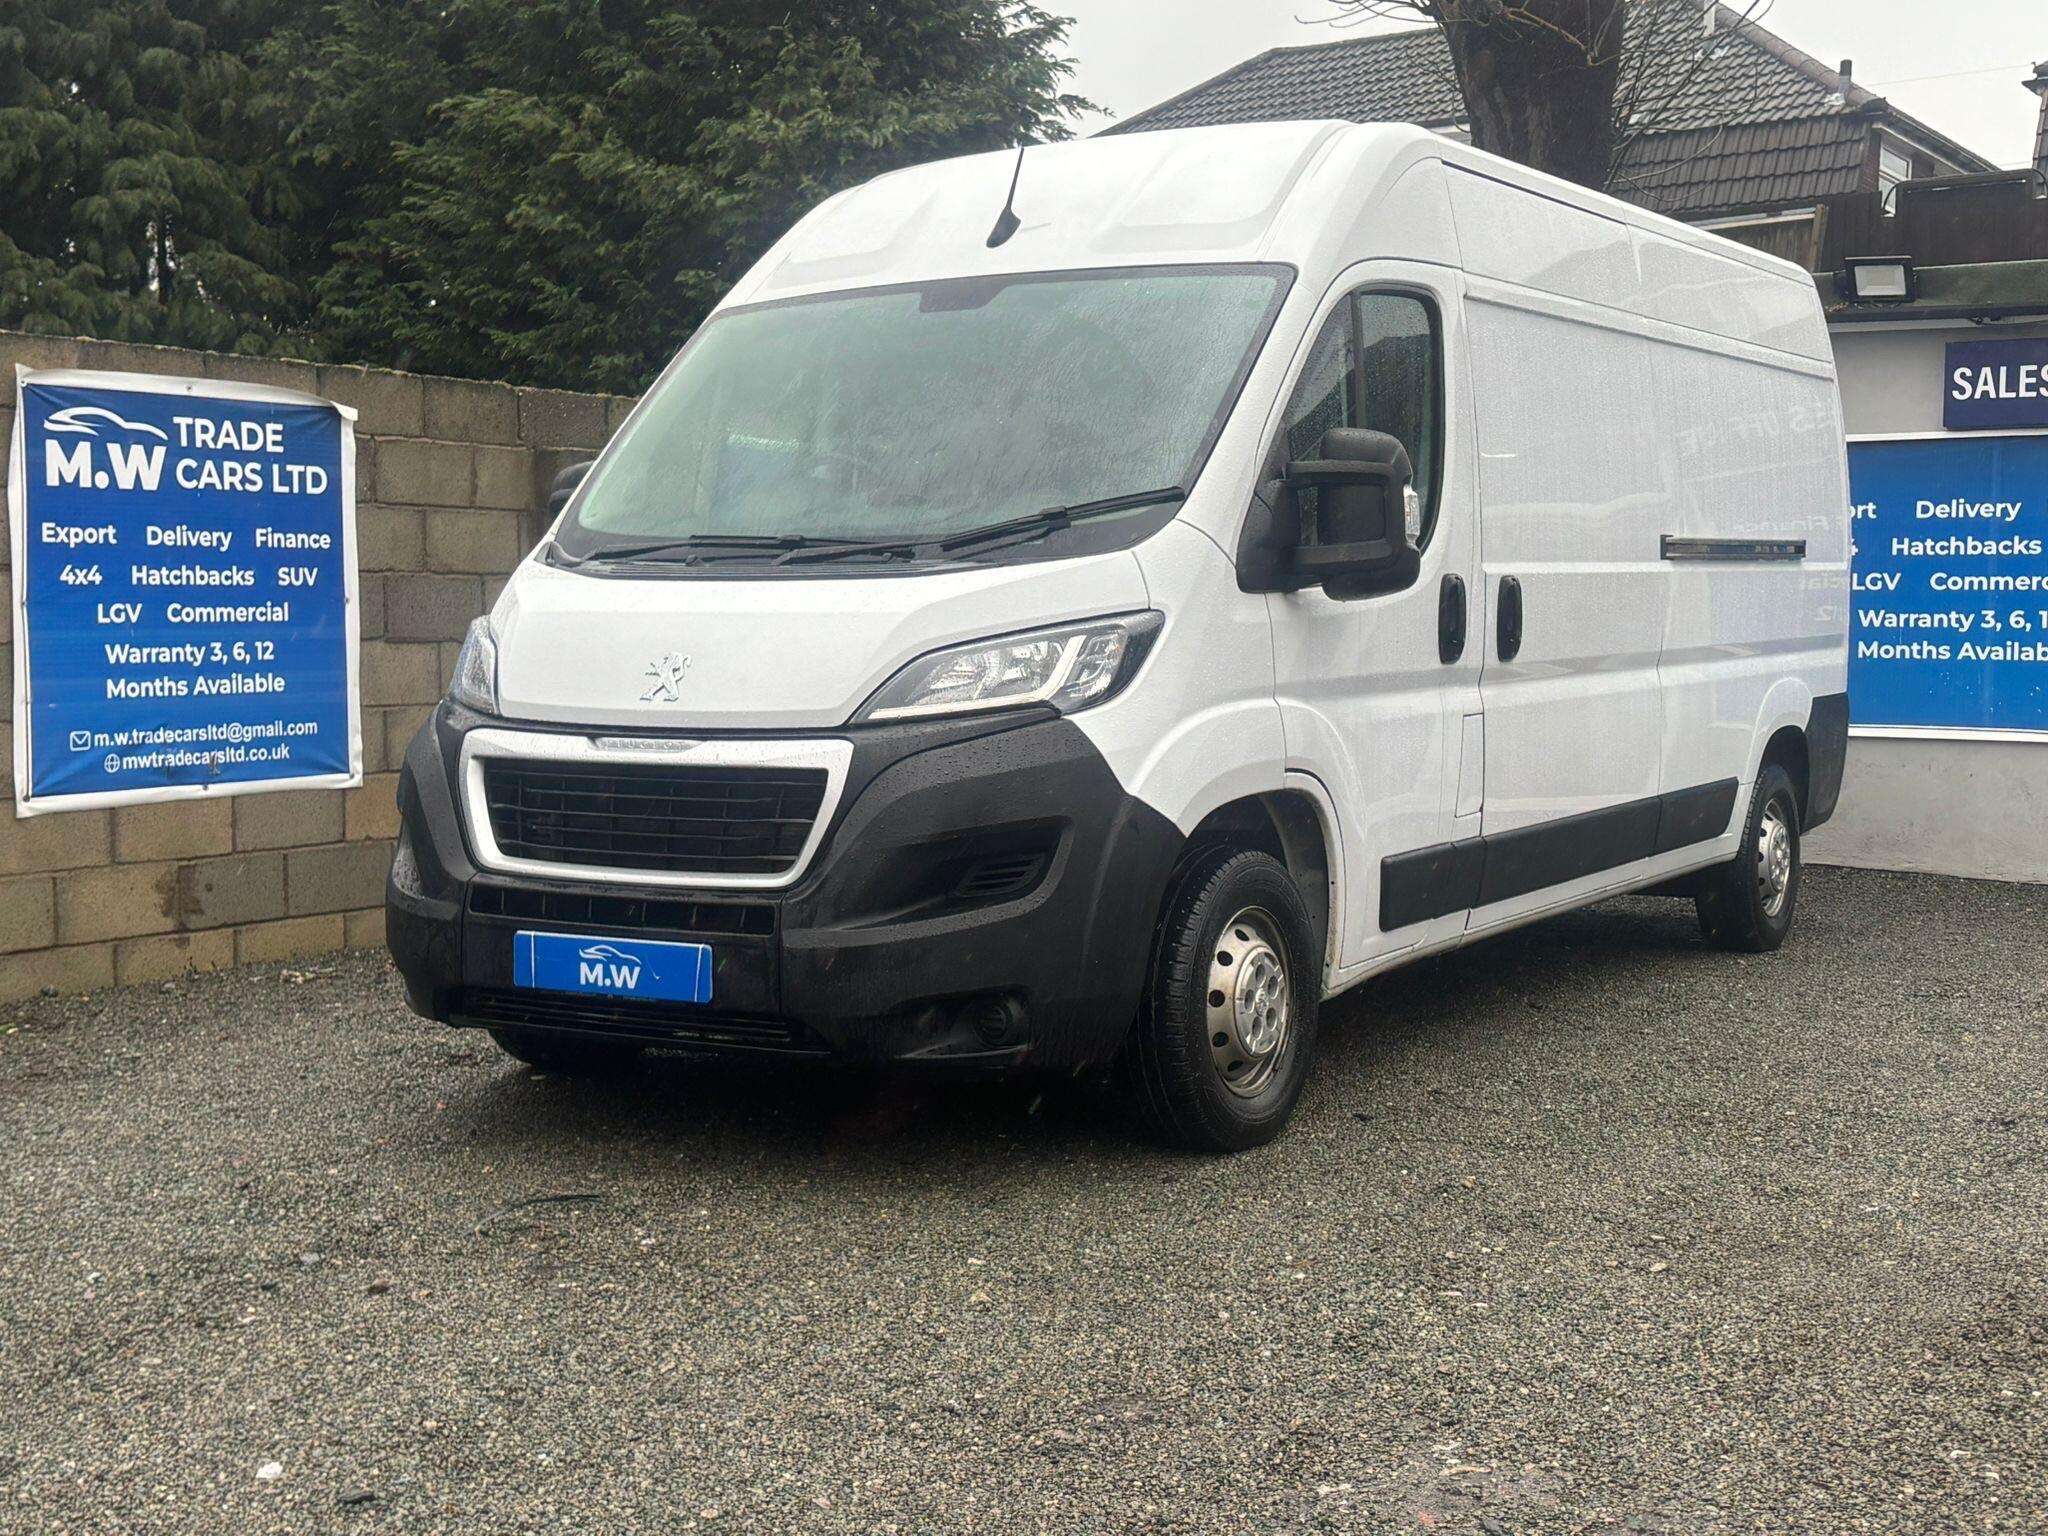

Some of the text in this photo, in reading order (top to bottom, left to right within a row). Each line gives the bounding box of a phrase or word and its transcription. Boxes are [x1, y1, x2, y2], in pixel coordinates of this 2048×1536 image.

[173, 417, 284, 453] TRADE
[45, 439, 167, 491] M.W
[175, 457, 328, 495] CARS LTD
[1916, 499, 2021, 521] Delivery
[42, 522, 331, 551] Export Delivery Finance
[1892, 536, 2041, 555] Hatchbacks
[60, 565, 317, 586] 4x4 Hatchbacks SUV
[1852, 573, 1901, 590] LGV
[98, 601, 288, 623] LGV Commercial
[1858, 610, 1974, 632] Warranty
[1981, 610, 2001, 631] 3,
[2010, 610, 2031, 631] 6,
[105, 641, 274, 666] Warranty 3, 6, 12
[1858, 641, 2048, 661] Months Availab
[106, 673, 285, 699] Months Available
[94, 720, 318, 747] m.w.tradecarsltd@gmail.com
[122, 743, 290, 769] mwtradecarsltd.co.uk
[580, 962, 640, 989] M.W
